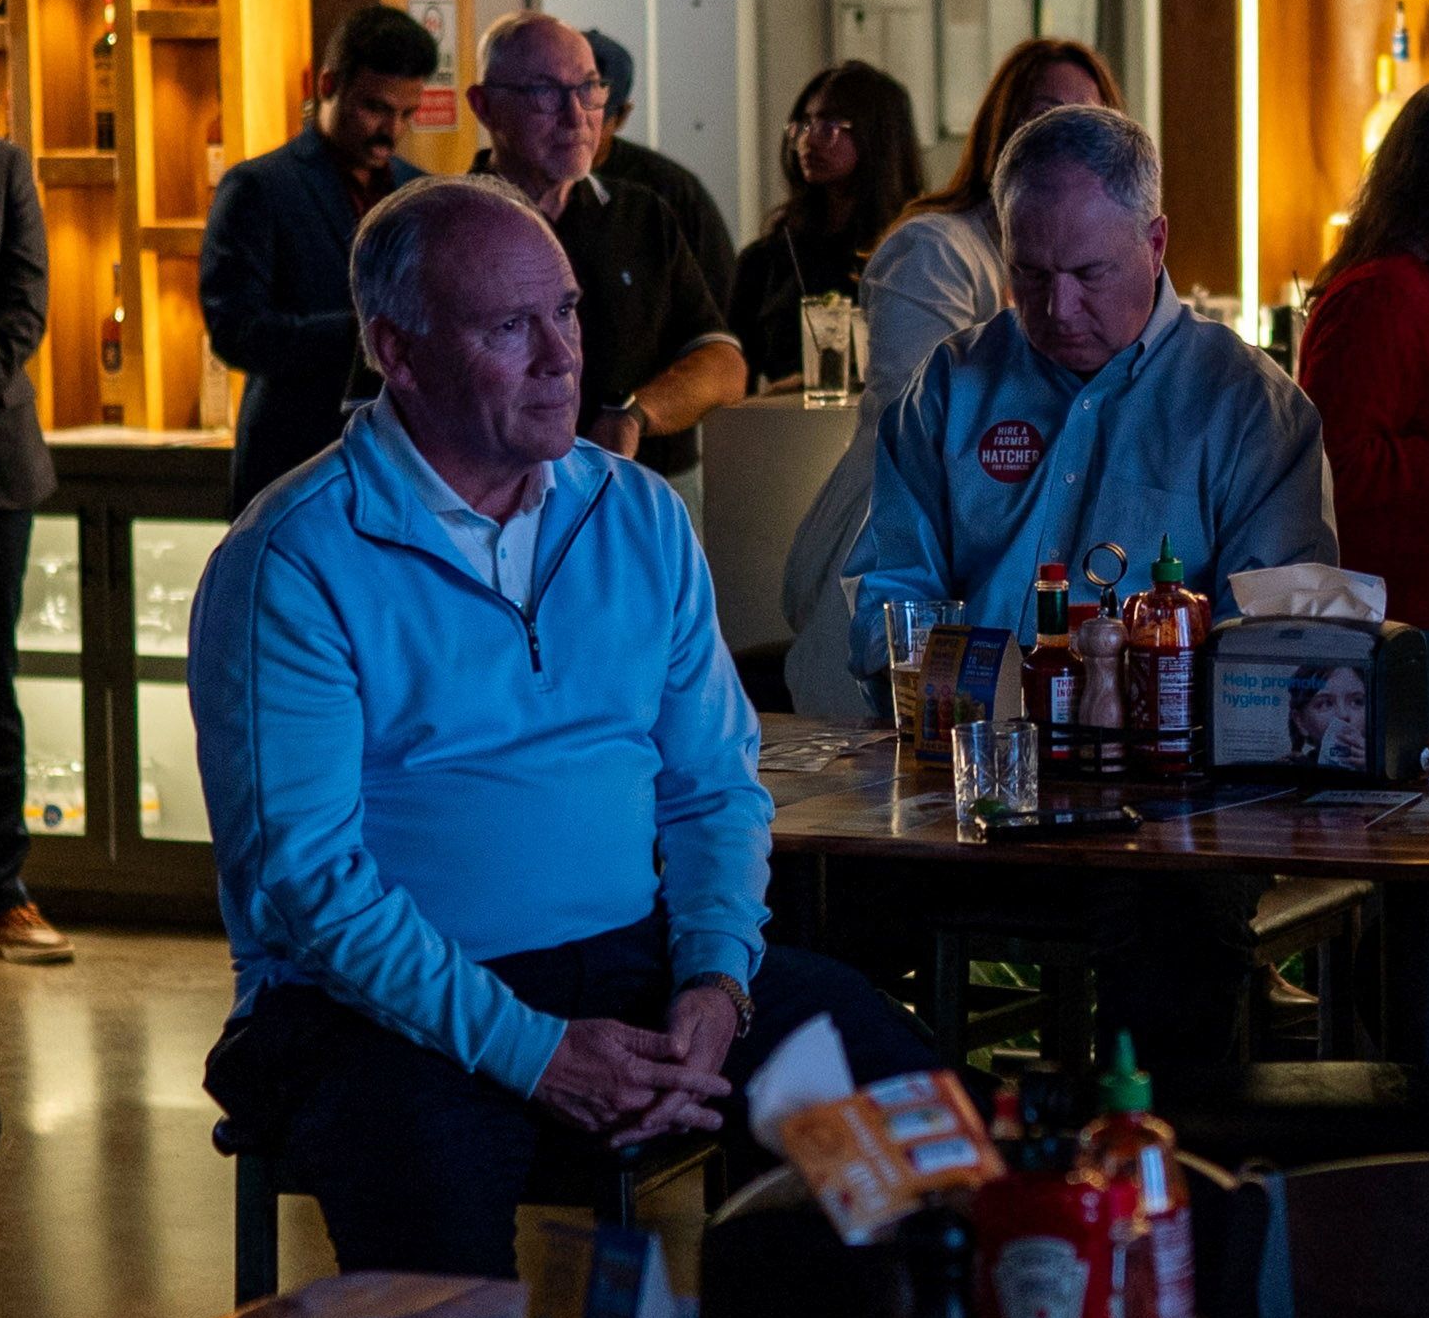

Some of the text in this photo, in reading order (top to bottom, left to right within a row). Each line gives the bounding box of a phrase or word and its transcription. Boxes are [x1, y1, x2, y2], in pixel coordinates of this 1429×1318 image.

[997, 426, 1028, 436] HIRE A
[993, 436, 1030, 446] FARMER
[982, 449, 1040, 463] HATCHER
[1223, 672, 1258, 690] Help
[1223, 692, 1281, 709] hygiene
